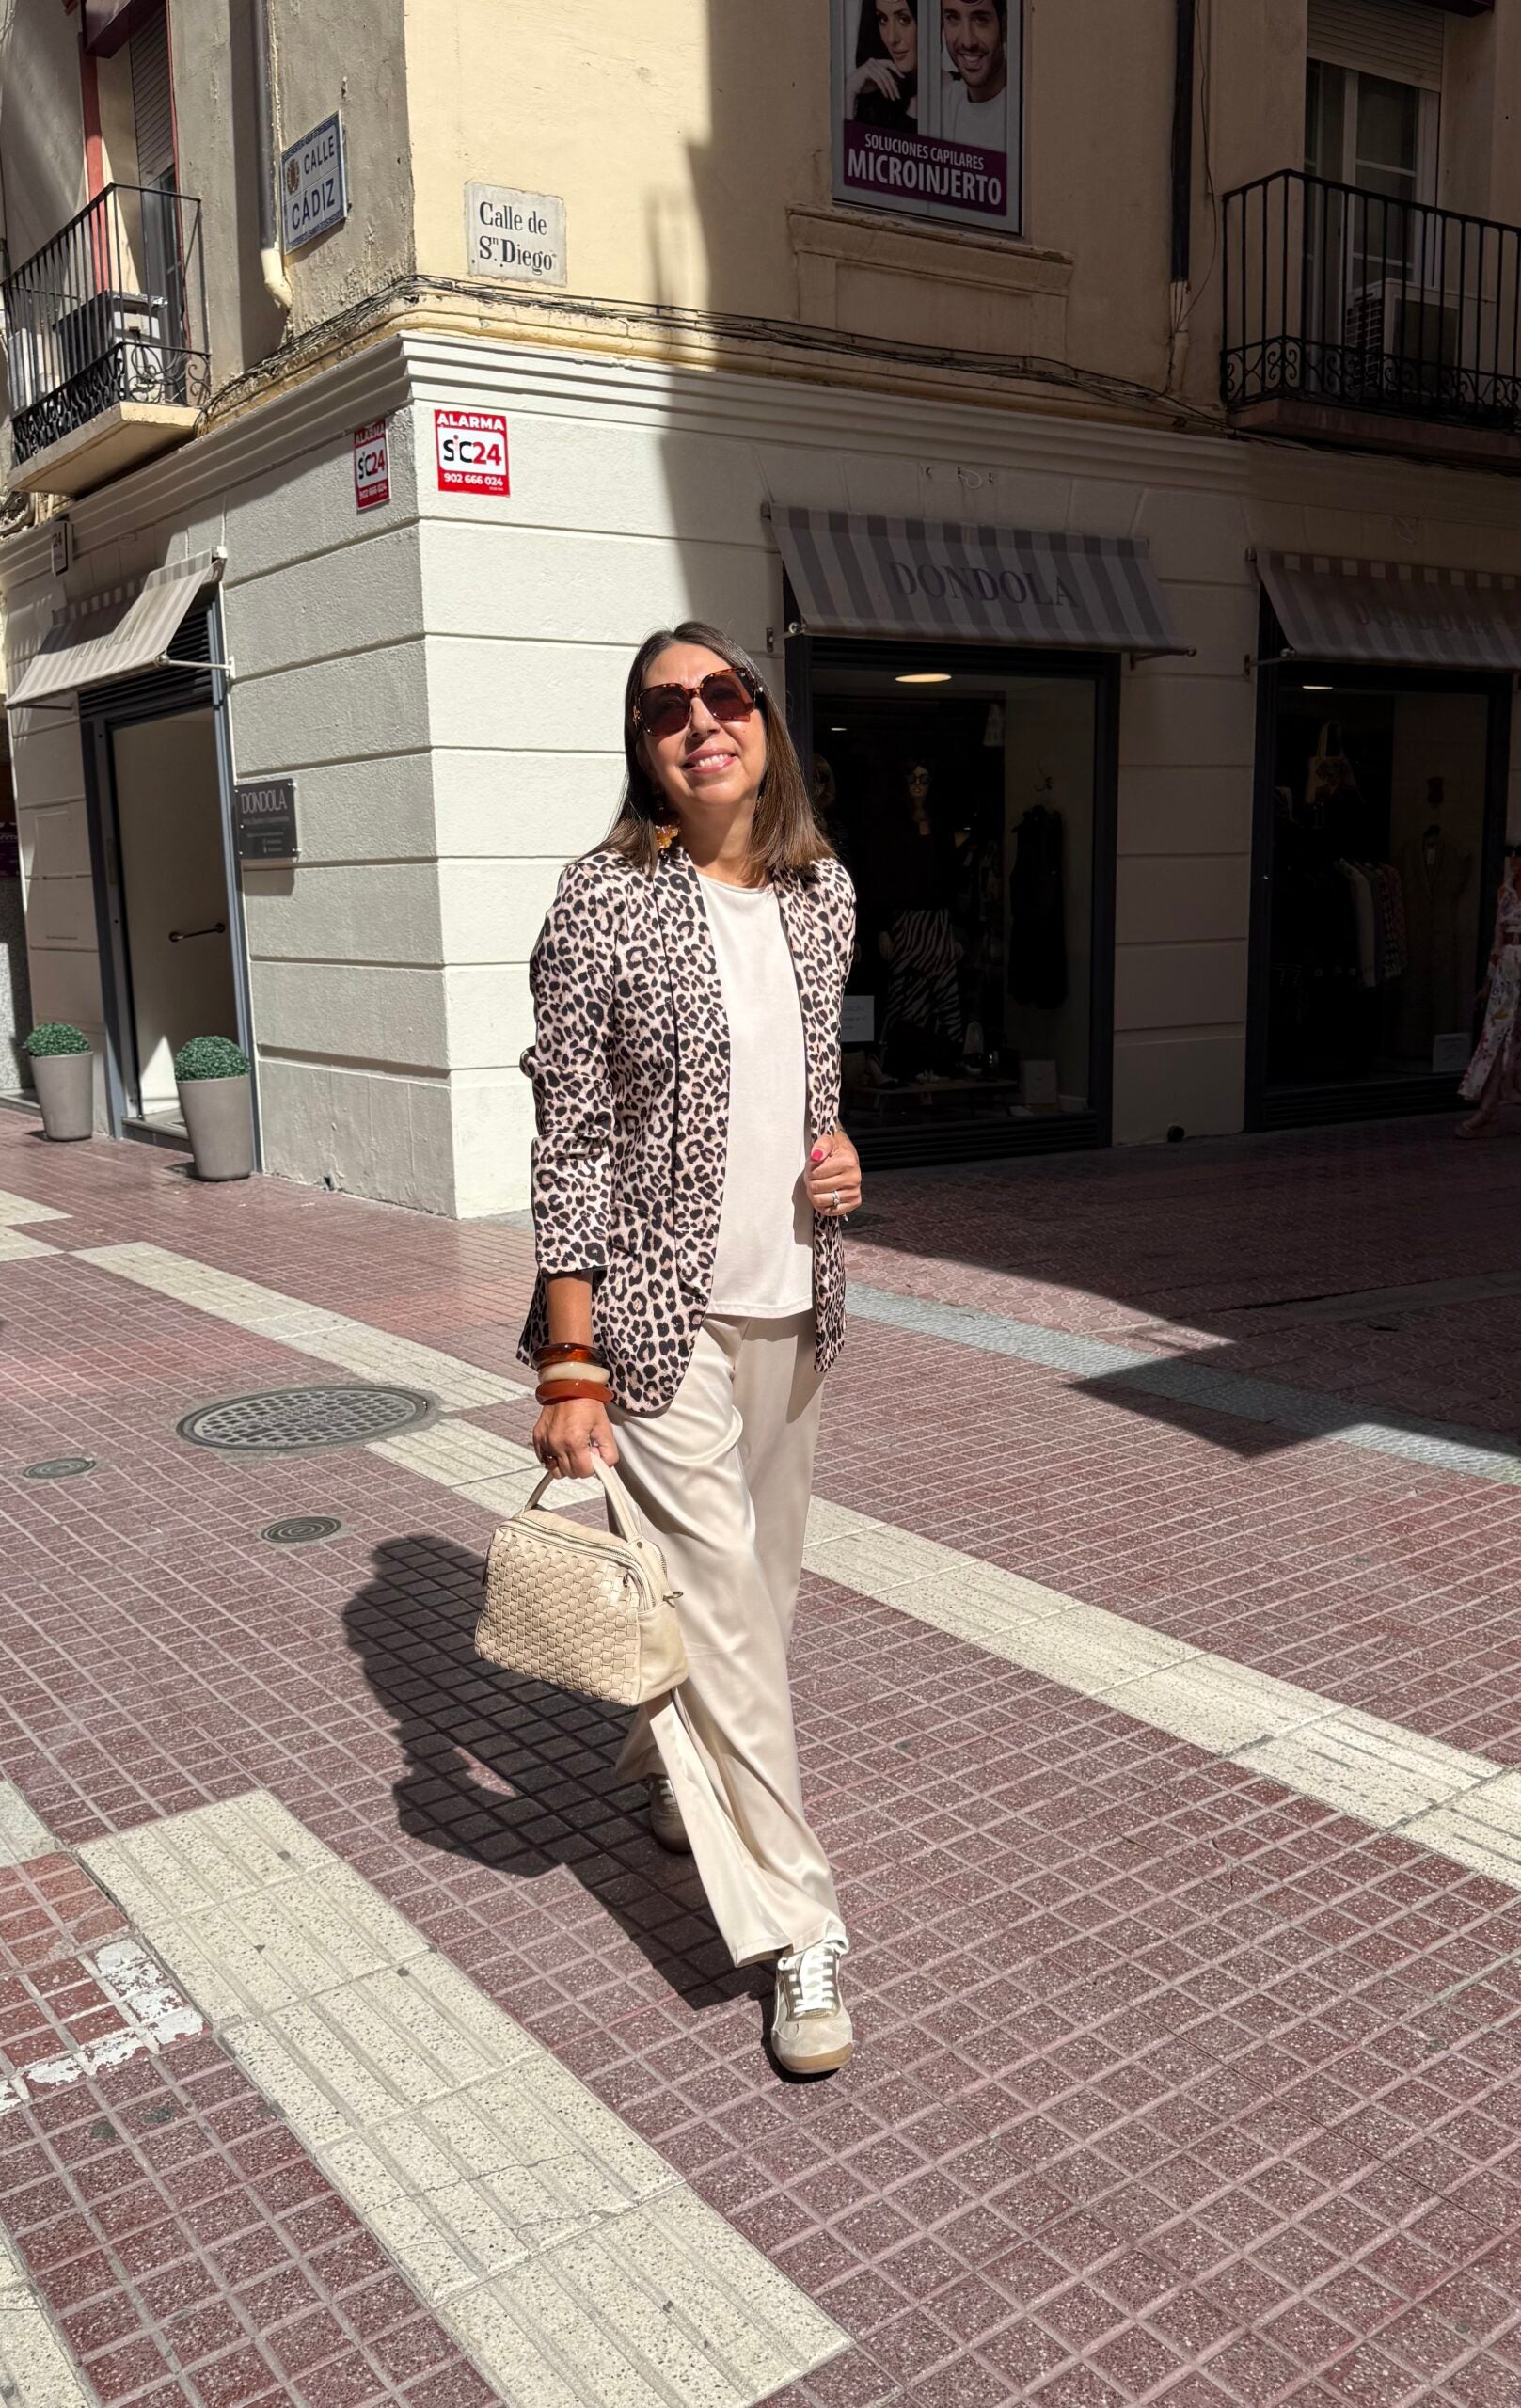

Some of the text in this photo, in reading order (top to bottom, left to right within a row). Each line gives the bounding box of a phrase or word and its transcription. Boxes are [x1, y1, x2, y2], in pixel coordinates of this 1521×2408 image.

[303, 135, 336, 175] CALLE
[864, 133, 985, 171] SOLUCIONES CAPILARES
[847, 149, 1002, 205] MICROINJERTO
[292, 177, 336, 230] CÁDIZ
[479, 201, 547, 235] Calle de
[500, 238, 553, 275] Diego
[437, 413, 504, 431] ALARMA
[444, 473, 504, 486] 902 666 024
[887, 561, 1081, 609] DONDOLA
[240, 789, 288, 815] DONDOLA
